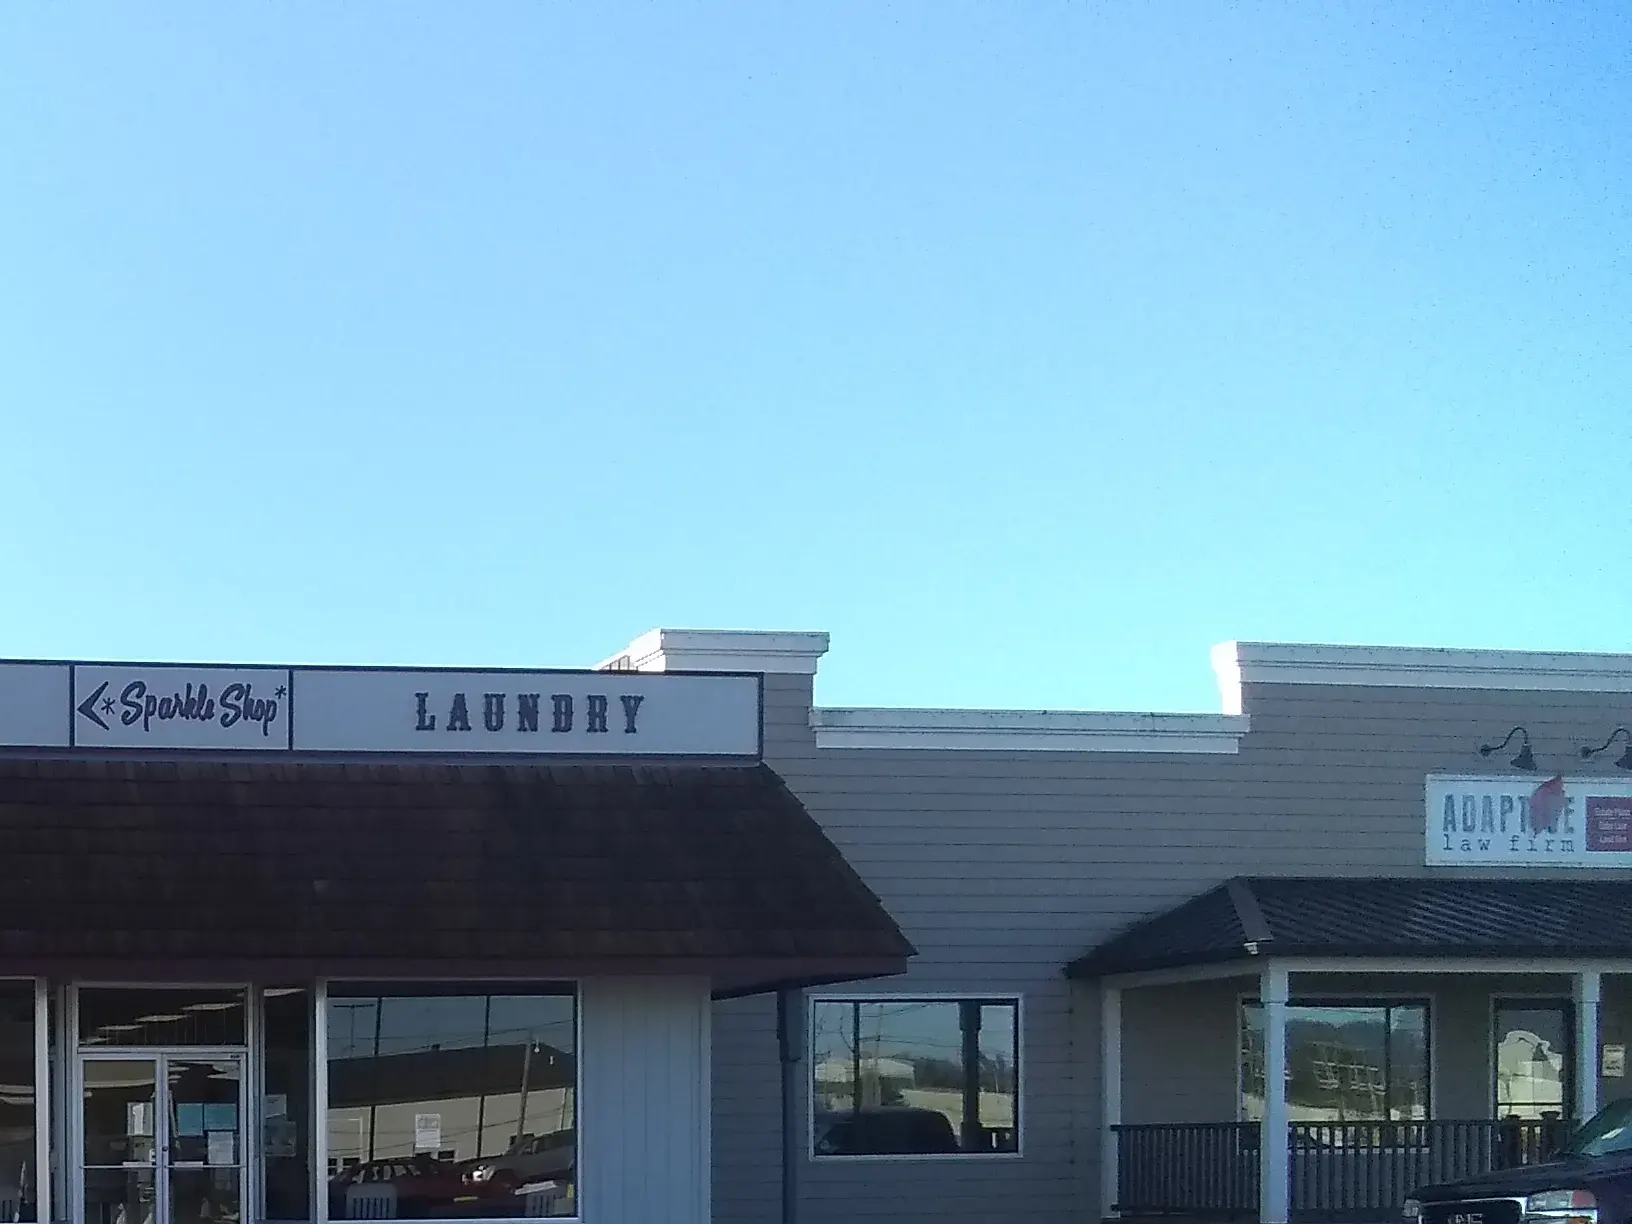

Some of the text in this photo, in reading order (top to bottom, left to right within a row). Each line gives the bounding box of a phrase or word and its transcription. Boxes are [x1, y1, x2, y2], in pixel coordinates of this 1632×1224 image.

[120, 680, 278, 737] Sparkle Shop
[414, 691, 645, 734] LAUNDRY
[1442, 833, 1491, 852] law
